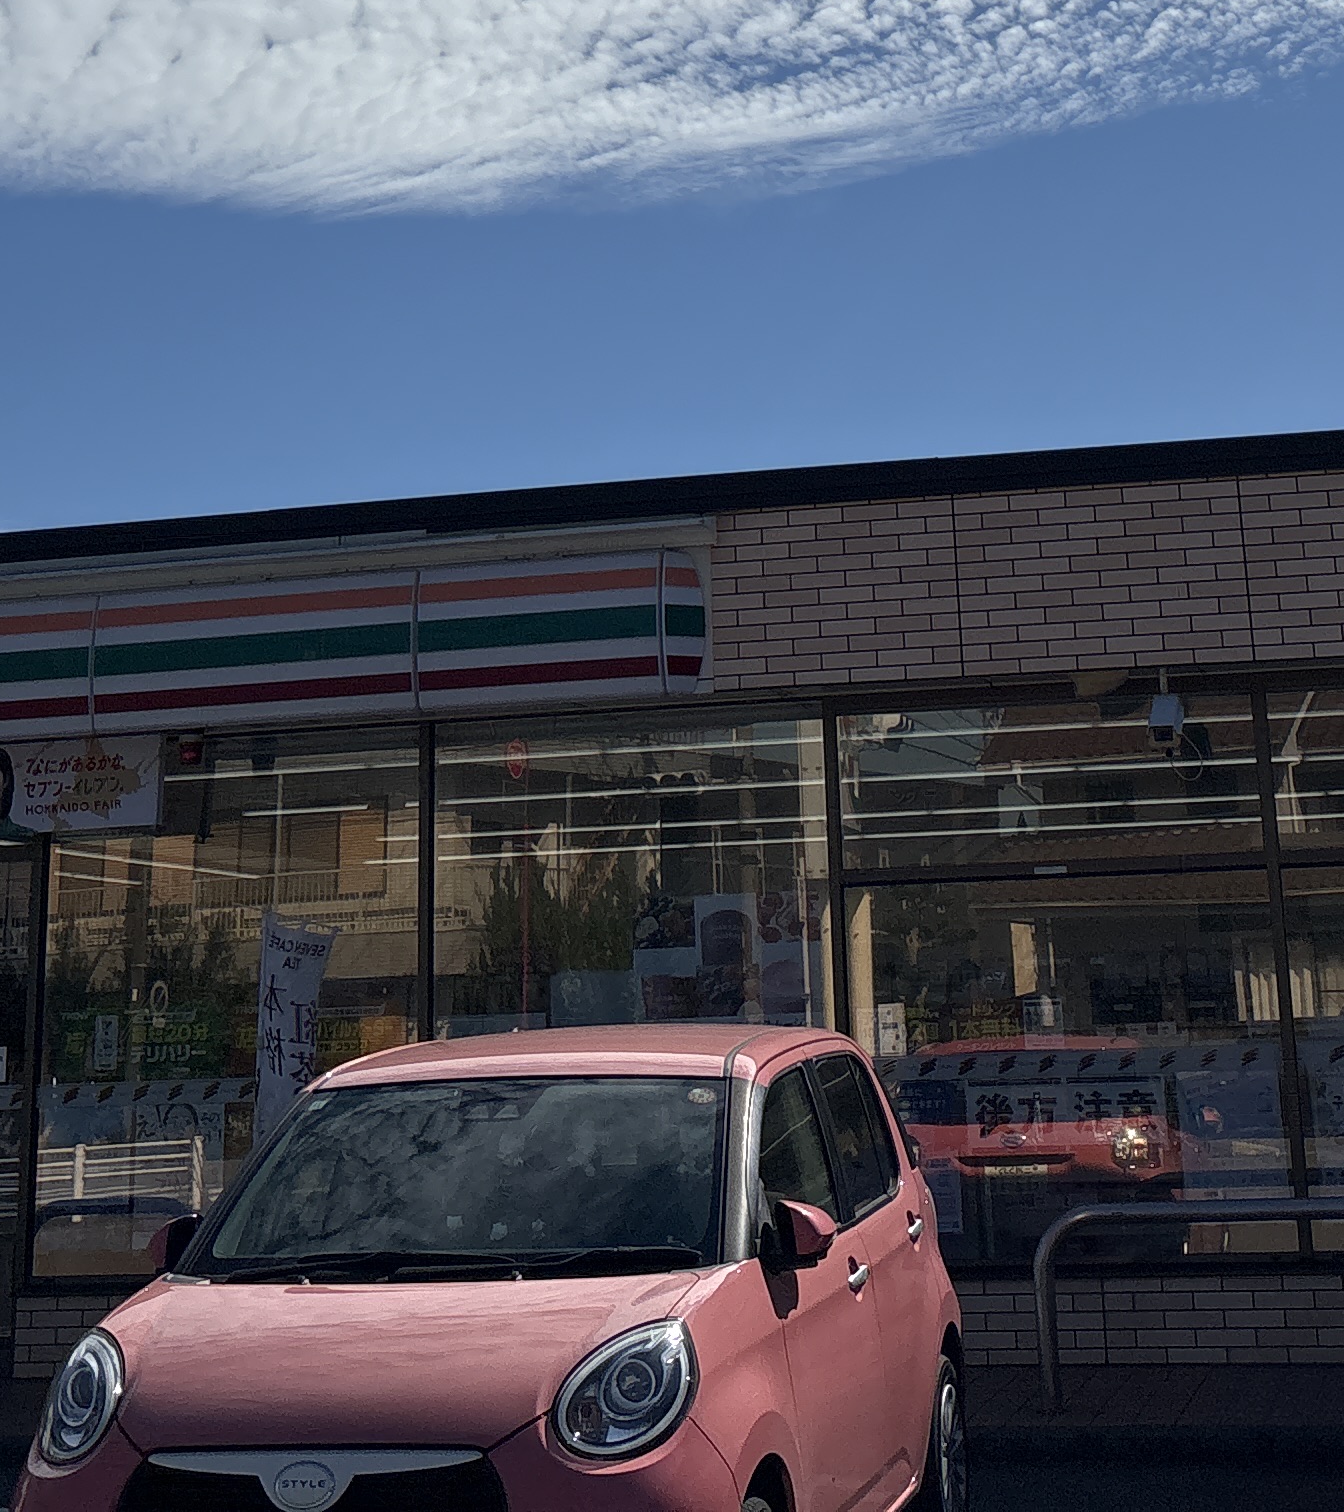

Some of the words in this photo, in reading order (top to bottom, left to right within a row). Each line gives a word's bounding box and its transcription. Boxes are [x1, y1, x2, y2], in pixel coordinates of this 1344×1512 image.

[25, 802, 89, 816] HOKKAIDO
[94, 799, 122, 811] FAIR
[281, 1479, 327, 1489] STYLE
